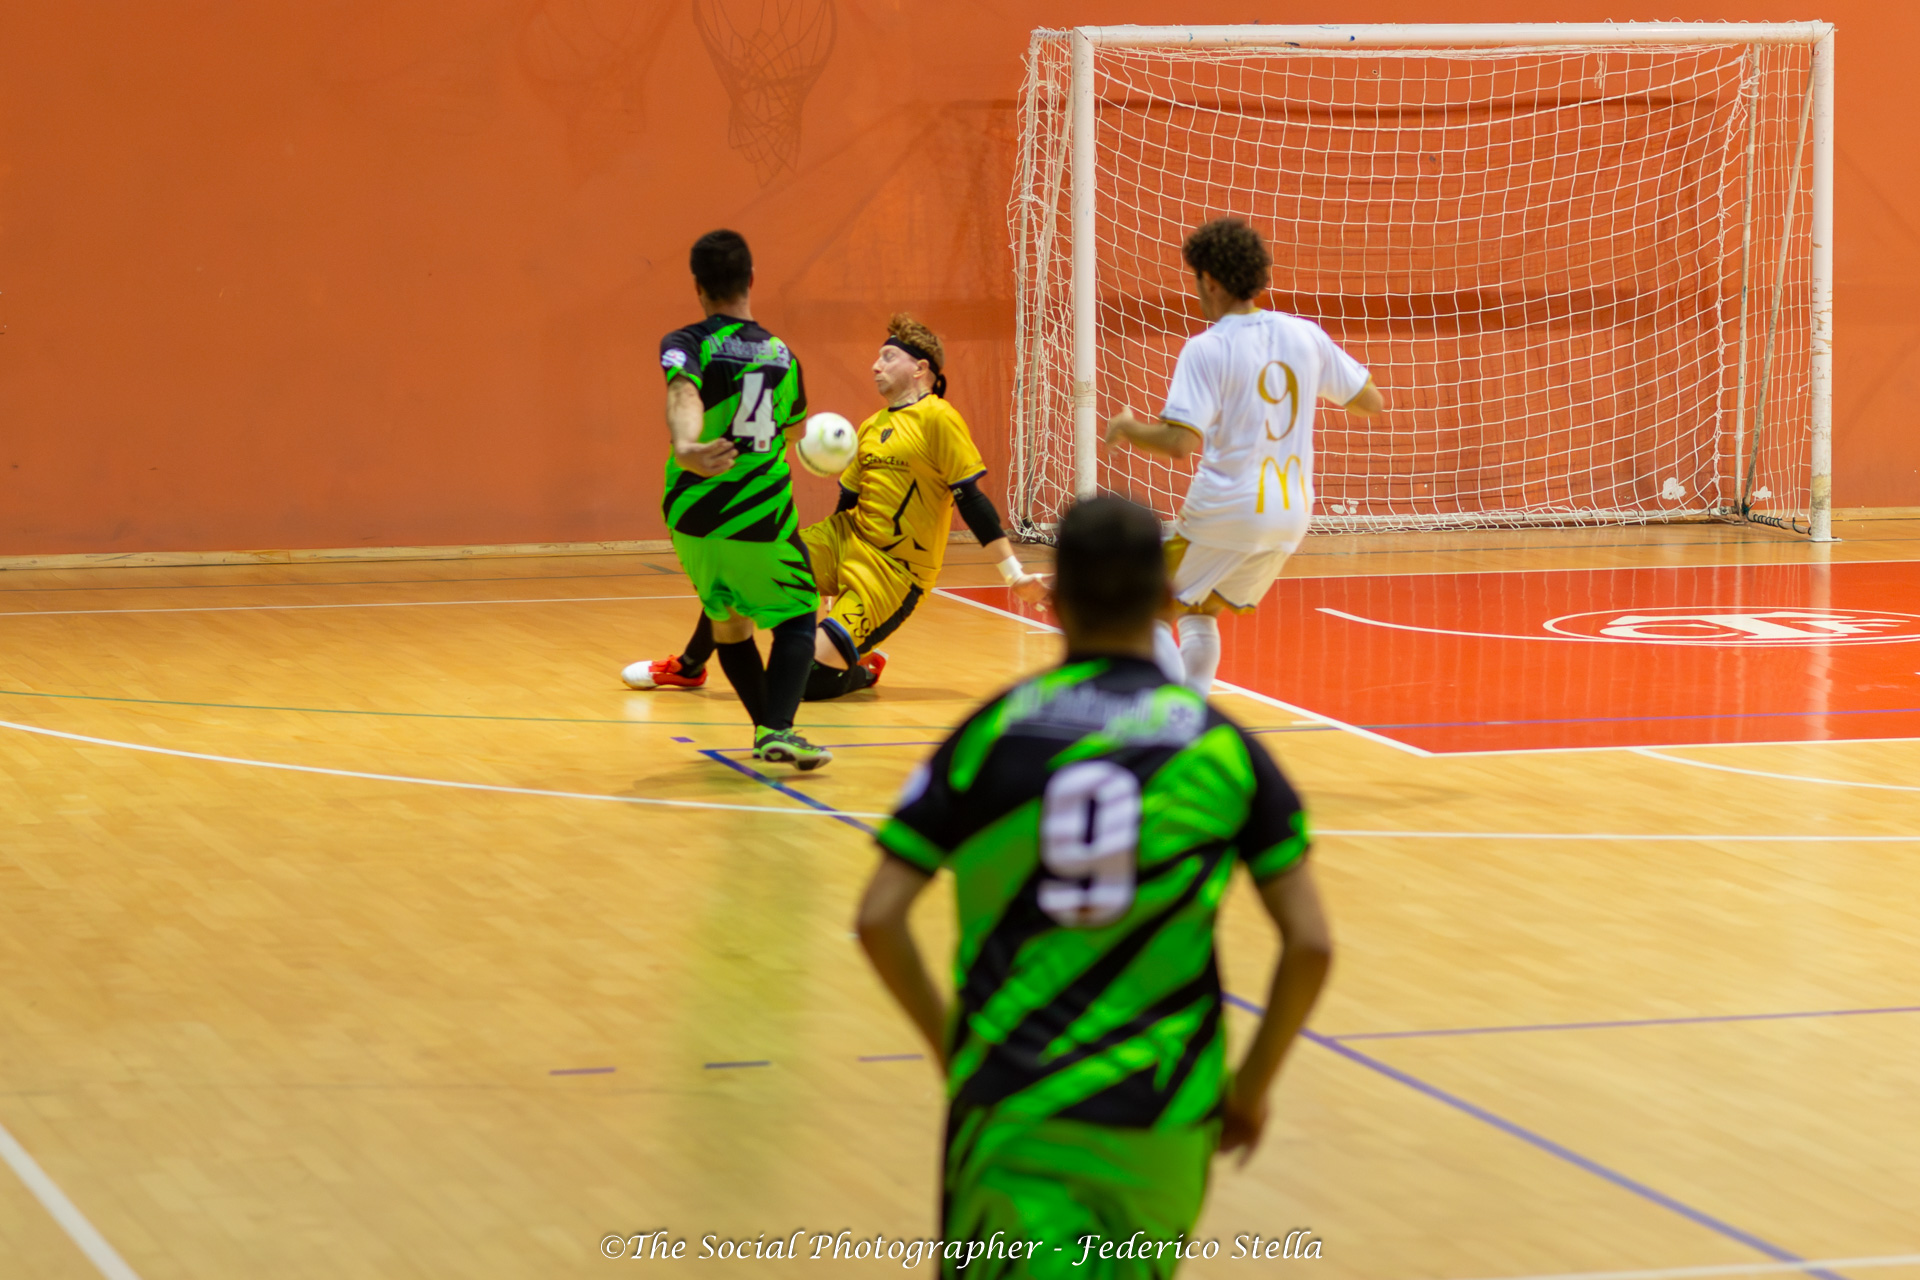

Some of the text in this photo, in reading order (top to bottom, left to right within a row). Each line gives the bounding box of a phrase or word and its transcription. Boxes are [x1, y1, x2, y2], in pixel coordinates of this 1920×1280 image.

[731, 372, 777, 452] 4
[1257, 360, 1299, 441] 9
[1036, 760, 1143, 928] 9
